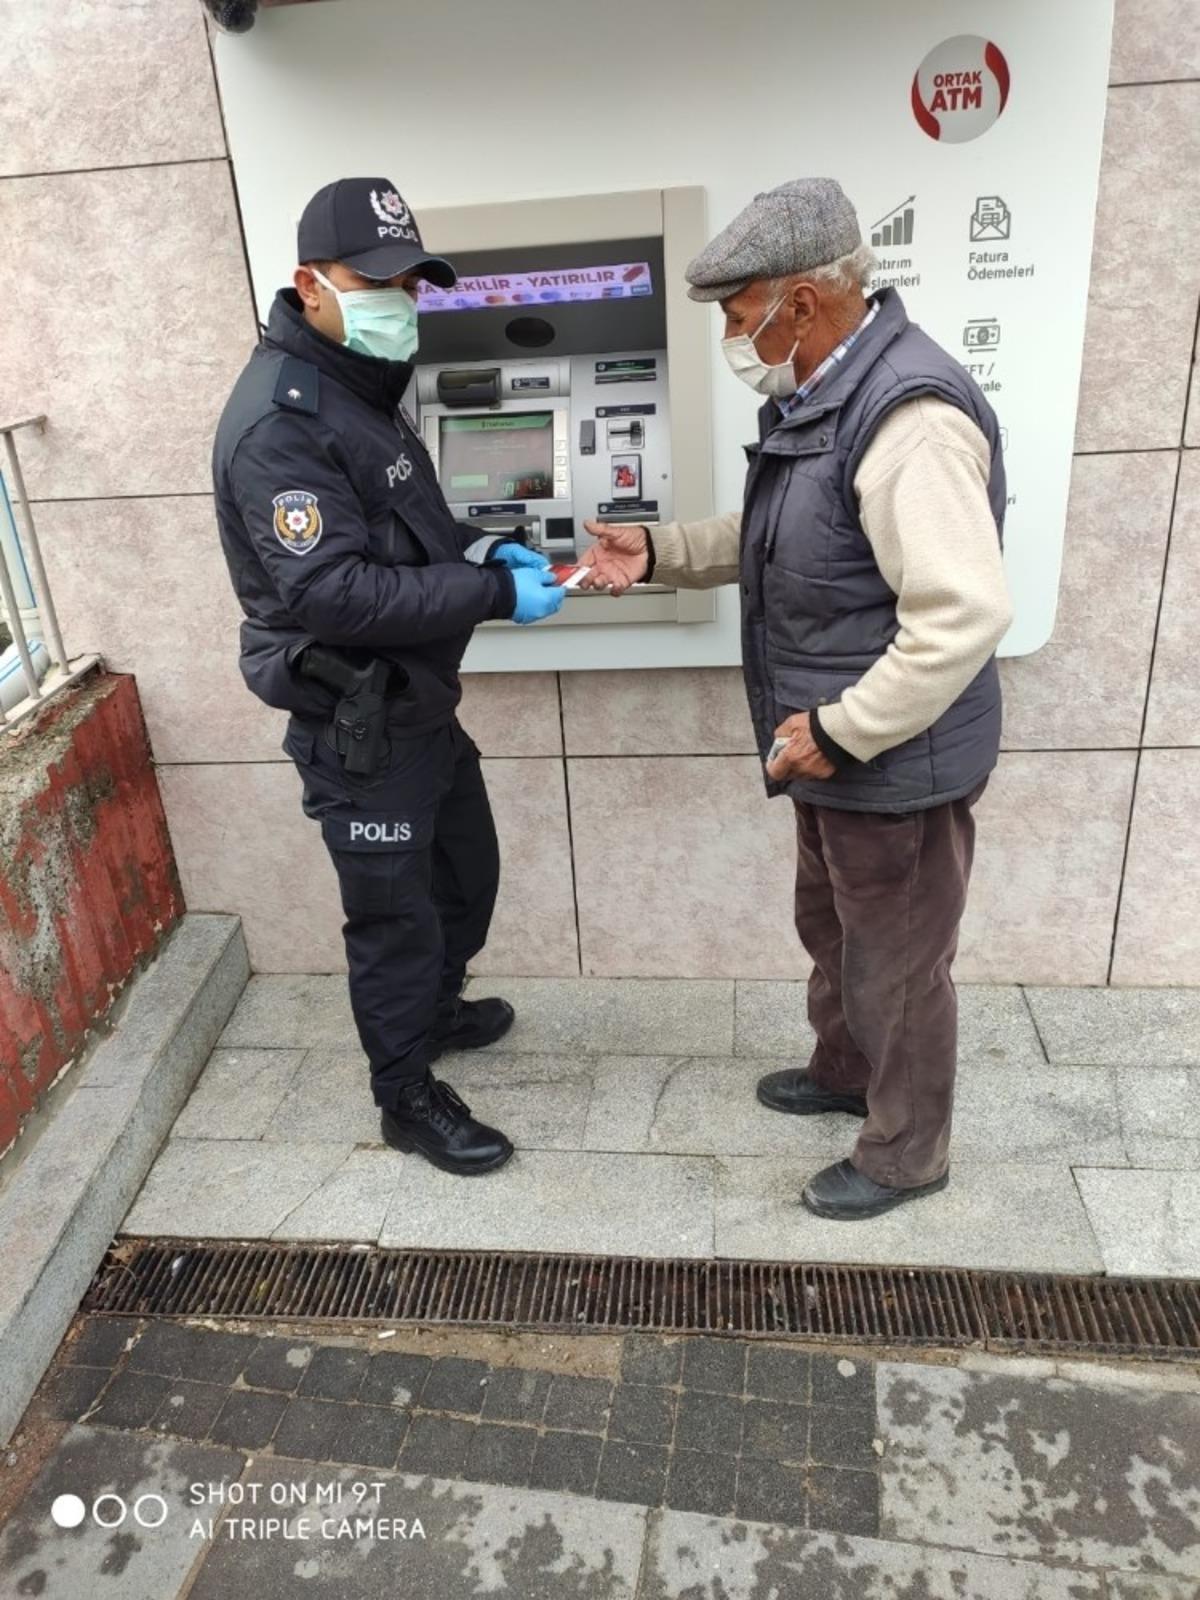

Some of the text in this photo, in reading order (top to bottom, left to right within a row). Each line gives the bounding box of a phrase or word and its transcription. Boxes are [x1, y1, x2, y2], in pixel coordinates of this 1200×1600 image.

[933, 71, 982, 88] ORTAK
[930, 86, 982, 112] ATM
[968, 252, 1009, 264] Fatura
[527, 271, 615, 288] YATIRILIR
[967, 264, 1034, 281] Ödemeleri
[871, 275, 921, 291] şlemleri
